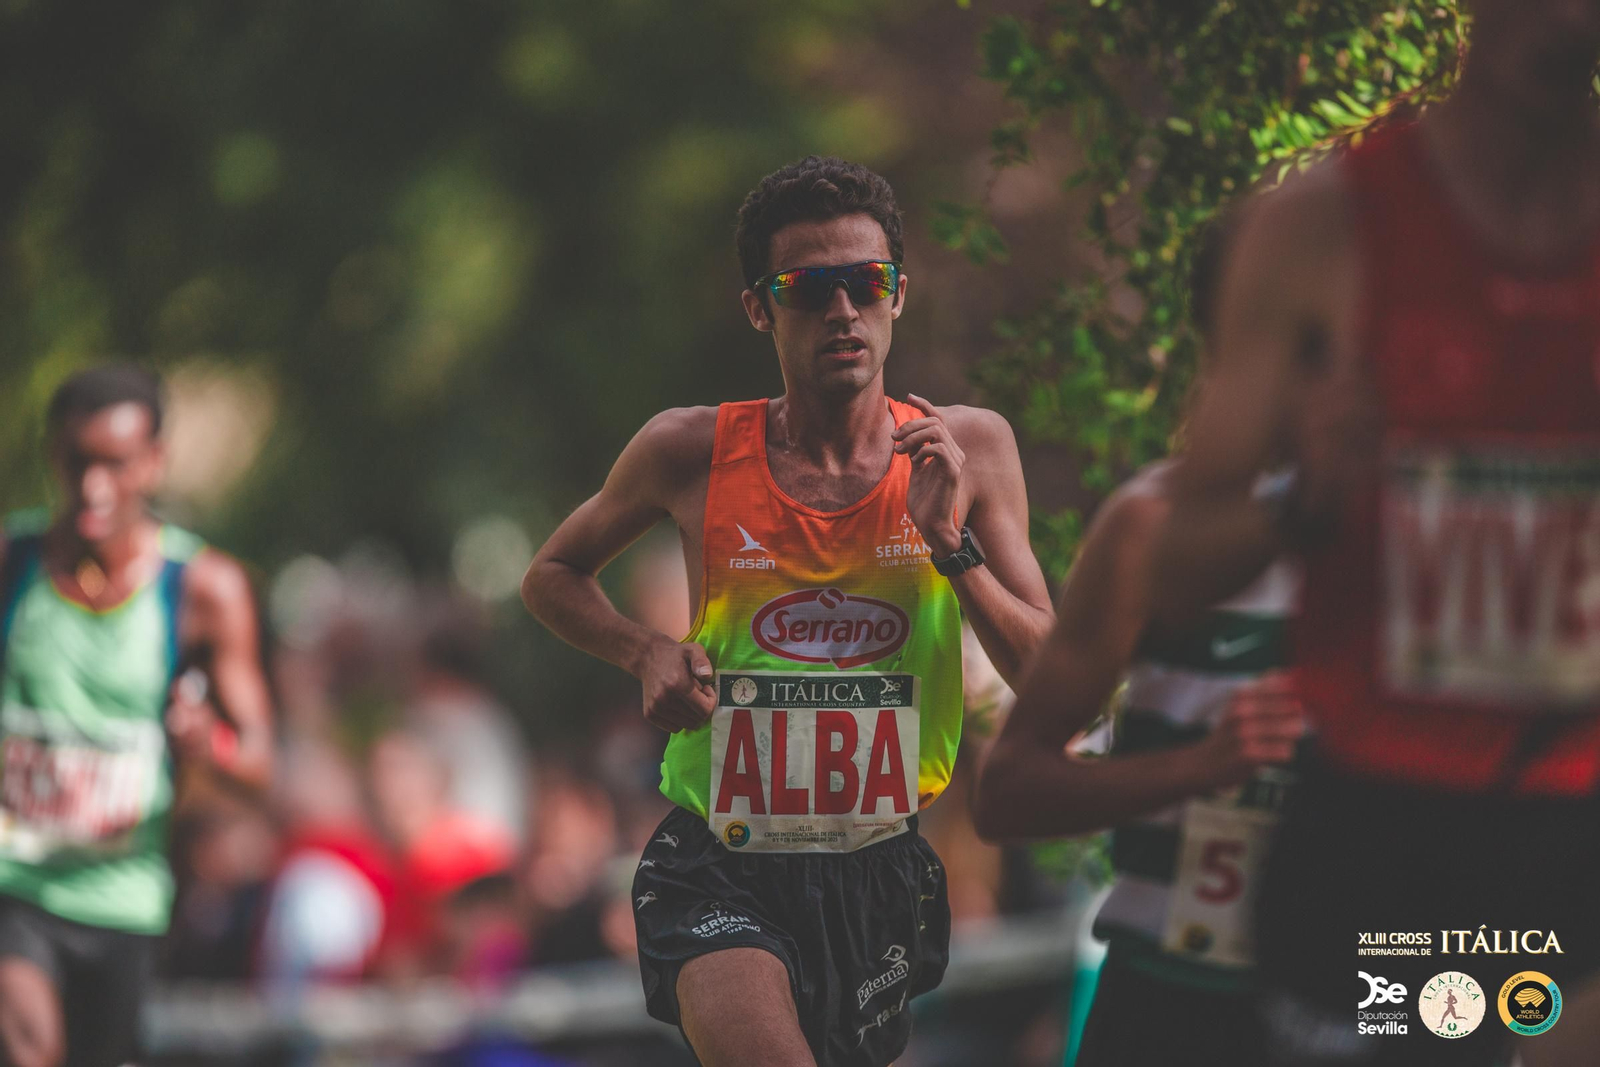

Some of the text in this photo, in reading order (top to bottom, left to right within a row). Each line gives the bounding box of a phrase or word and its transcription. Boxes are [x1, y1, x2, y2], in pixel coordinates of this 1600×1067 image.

[876, 542, 933, 558] SERRAN
[730, 557, 775, 569] rasán
[880, 557, 931, 567] CLUB ATLETIS
[767, 610, 897, 643] Serrano
[771, 679, 865, 702] ITÁLICA
[715, 709, 911, 815] ALBA
[692, 915, 751, 934] SERRAN
[700, 928, 720, 938] CLUB
[857, 965, 905, 1005] Paterna
